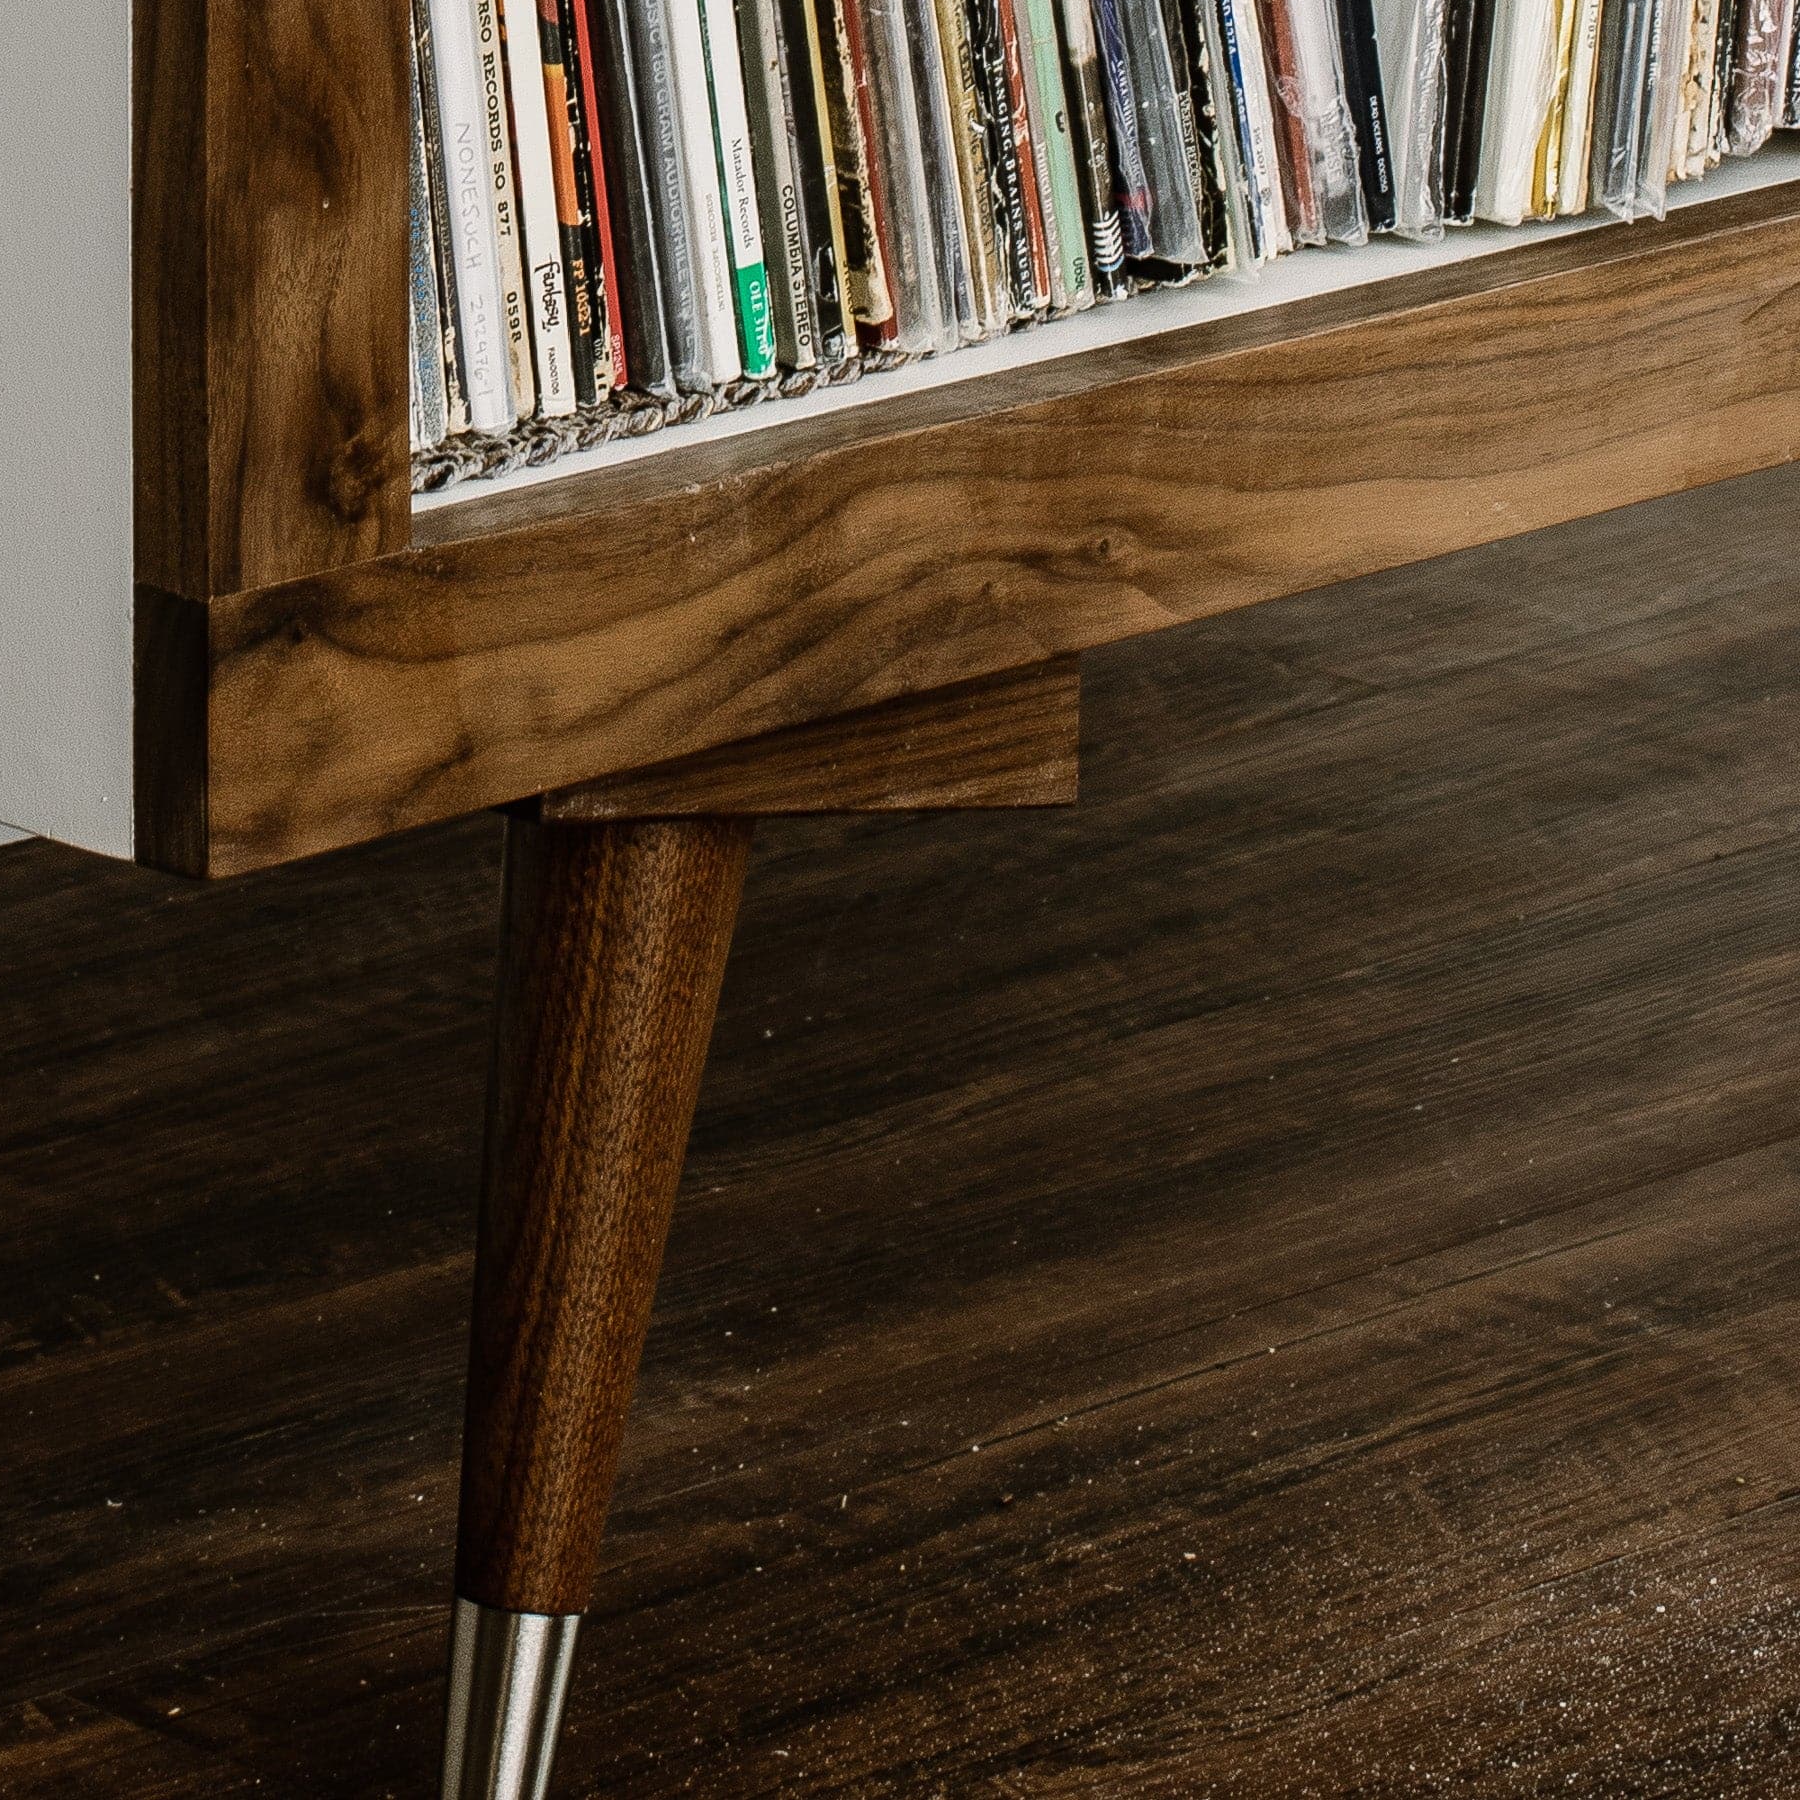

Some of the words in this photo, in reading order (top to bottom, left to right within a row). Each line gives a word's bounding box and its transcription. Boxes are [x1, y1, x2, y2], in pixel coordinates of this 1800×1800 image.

[474, 0, 494, 44] RSO
[479, 52, 505, 152] RECORDS
[654, 88, 676, 151] GRAM
[1367, 94, 1380, 119] DEAD
[490, 161, 509, 190] SO
[730, 138, 748, 191] Matador
[453, 122, 483, 270] NONESUCH
[495, 201, 512, 237] 877
[704, 193, 718, 242] RECORDS
[1001, 159, 1025, 231] BRAINS
[736, 197, 755, 250] Records
[779, 184, 804, 277] COLUMBIA
[569, 258, 586, 279] FP
[711, 246, 726, 312] INTERSCOPE
[573, 284, 594, 337] 1032-1
[744, 279, 766, 313] OLE
[791, 279, 812, 347] STEREO
